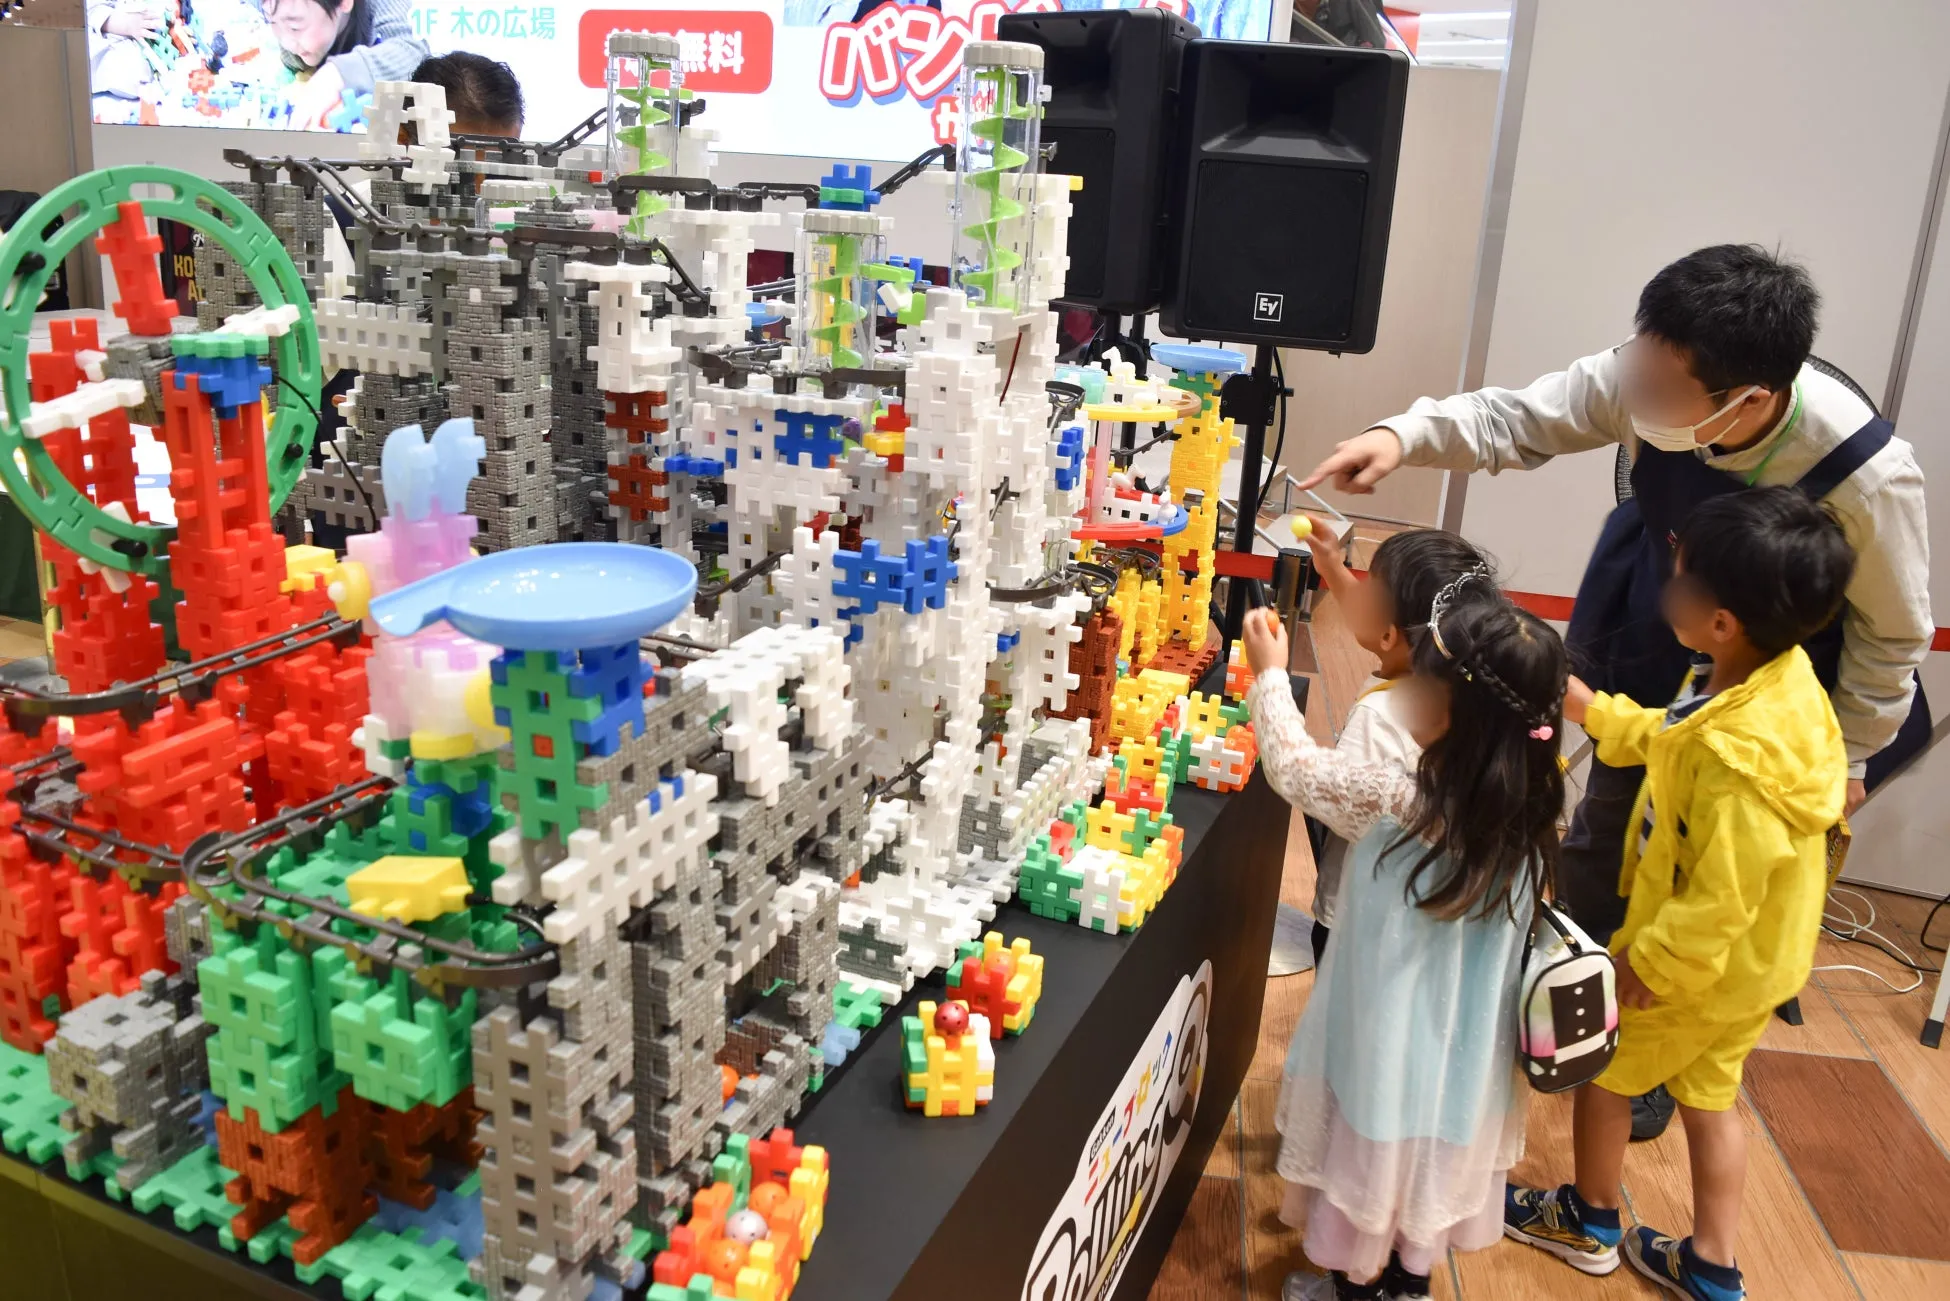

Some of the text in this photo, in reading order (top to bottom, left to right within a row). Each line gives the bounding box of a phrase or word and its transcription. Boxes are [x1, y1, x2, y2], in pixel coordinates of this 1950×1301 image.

[411, 7, 556, 40] 1F 木の広場
[604, 28, 744, 84] 無料
